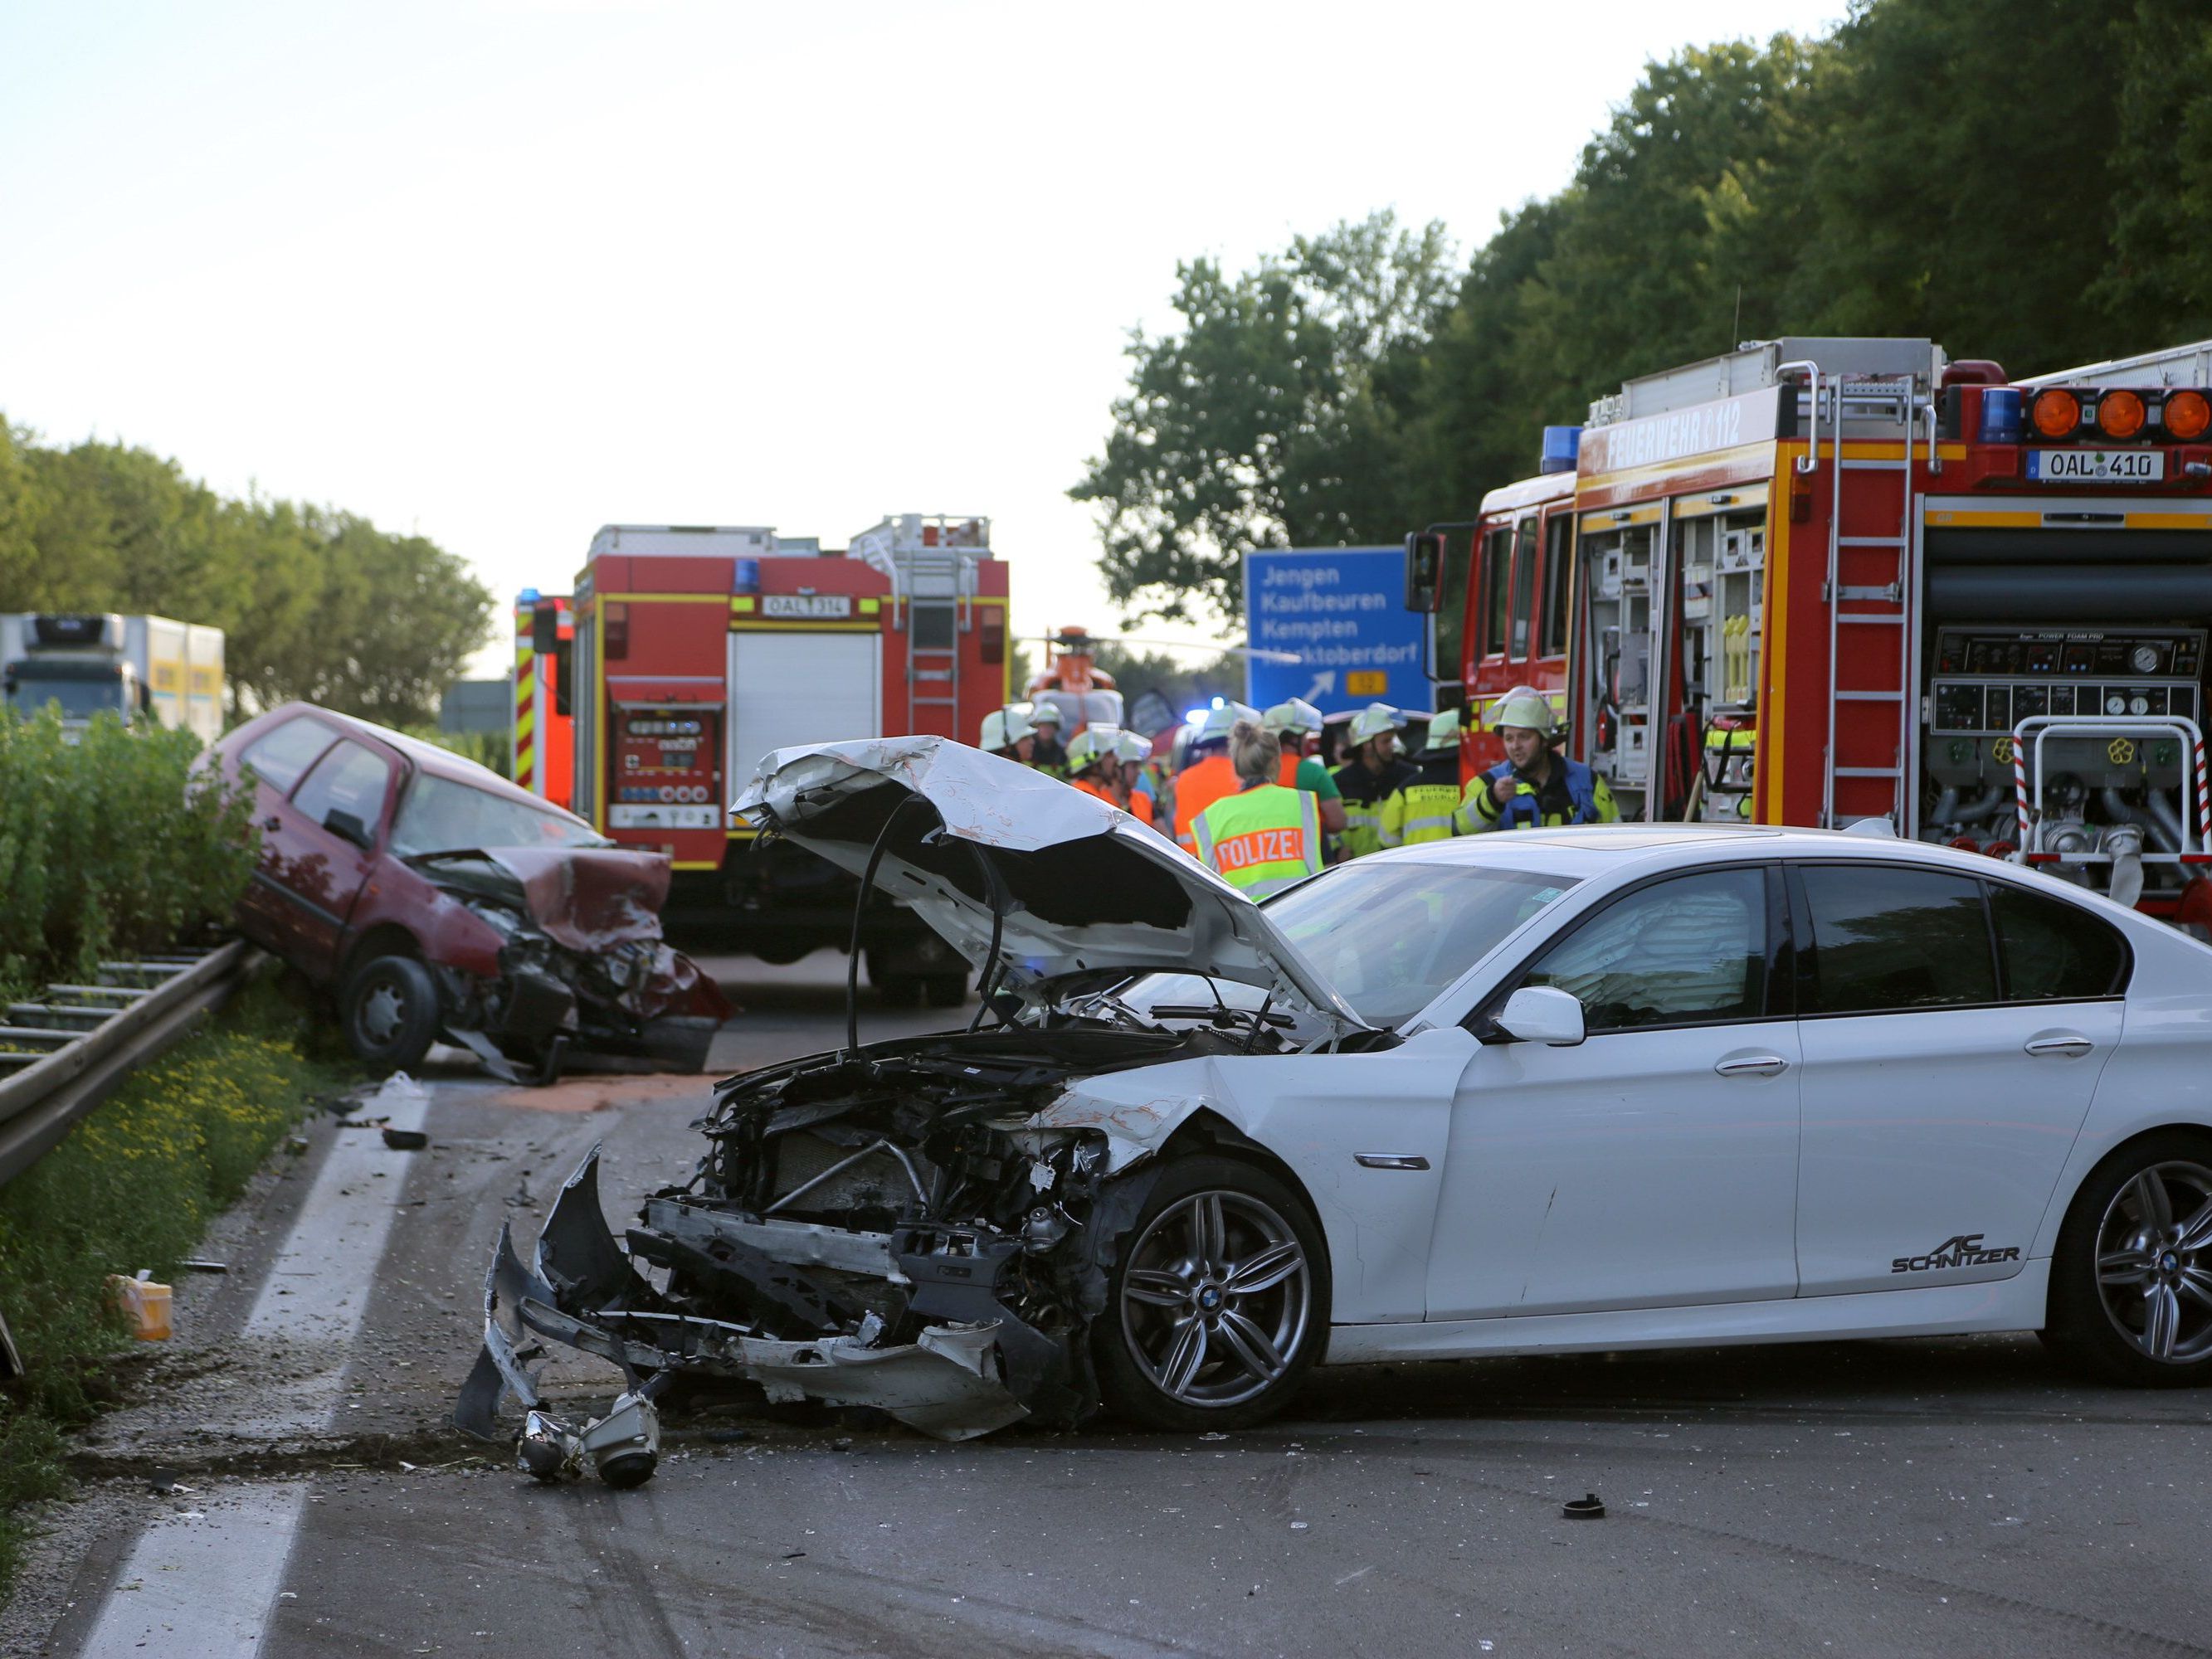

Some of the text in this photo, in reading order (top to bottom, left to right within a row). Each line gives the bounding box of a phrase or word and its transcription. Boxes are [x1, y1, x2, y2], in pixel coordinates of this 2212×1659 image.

[1607, 401, 1740, 469] FEUERWEHR 112
[2050, 454, 2151, 476] OAL 410
[1261, 566, 1339, 589] Jengen
[1260, 591, 1386, 612] Kaufbeuren
[1260, 618, 1358, 640] Kempten
[2088, 632, 2104, 640] PRO
[1262, 642, 1418, 665] ktoberdorf
[1217, 830, 1302, 867] POLIZEI
[1930, 1233, 1985, 1255] AC
[1891, 1246, 2020, 1273] SCHNITZER
